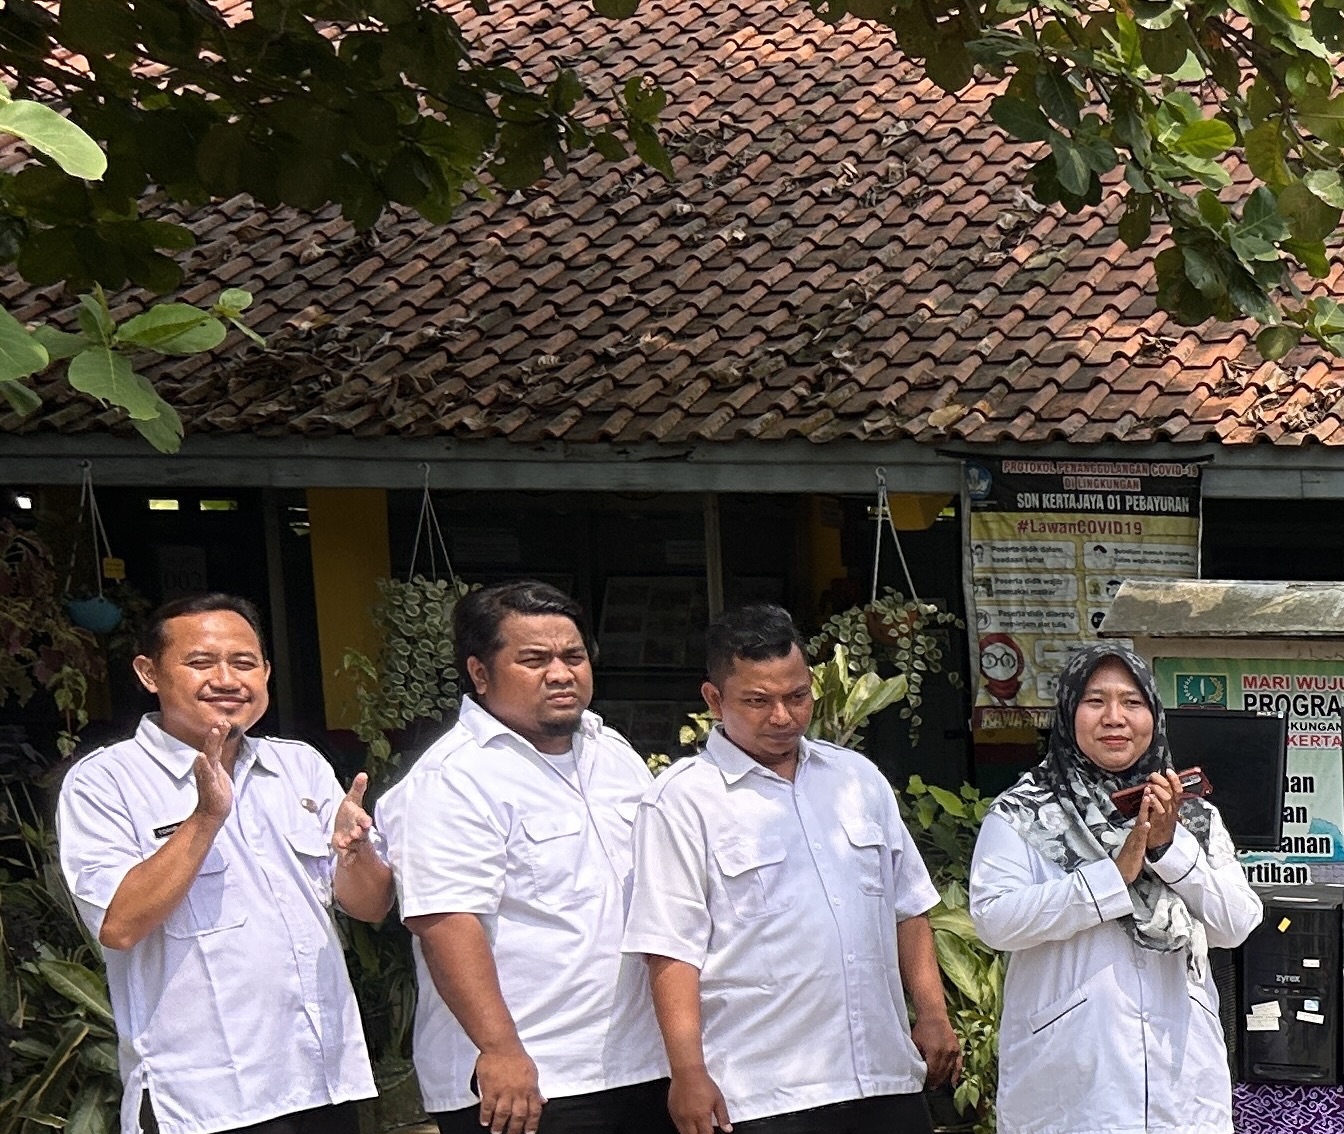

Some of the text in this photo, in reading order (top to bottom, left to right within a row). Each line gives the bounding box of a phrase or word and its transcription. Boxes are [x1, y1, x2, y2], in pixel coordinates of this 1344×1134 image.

[1002, 460, 1056, 474] PROTOKOL
[1150, 463, 1199, 478] COVID-19
[1063, 477, 1142, 491] DI LINGKUNGAN
[1016, 492, 1190, 513] SDN KERTAJAYA 01 PEBAYURAN
[1017, 519, 1143, 536] #LawanCOVID19
[1243, 675, 1290, 690] MARI
[1287, 721, 1342, 732] KUNGAN
